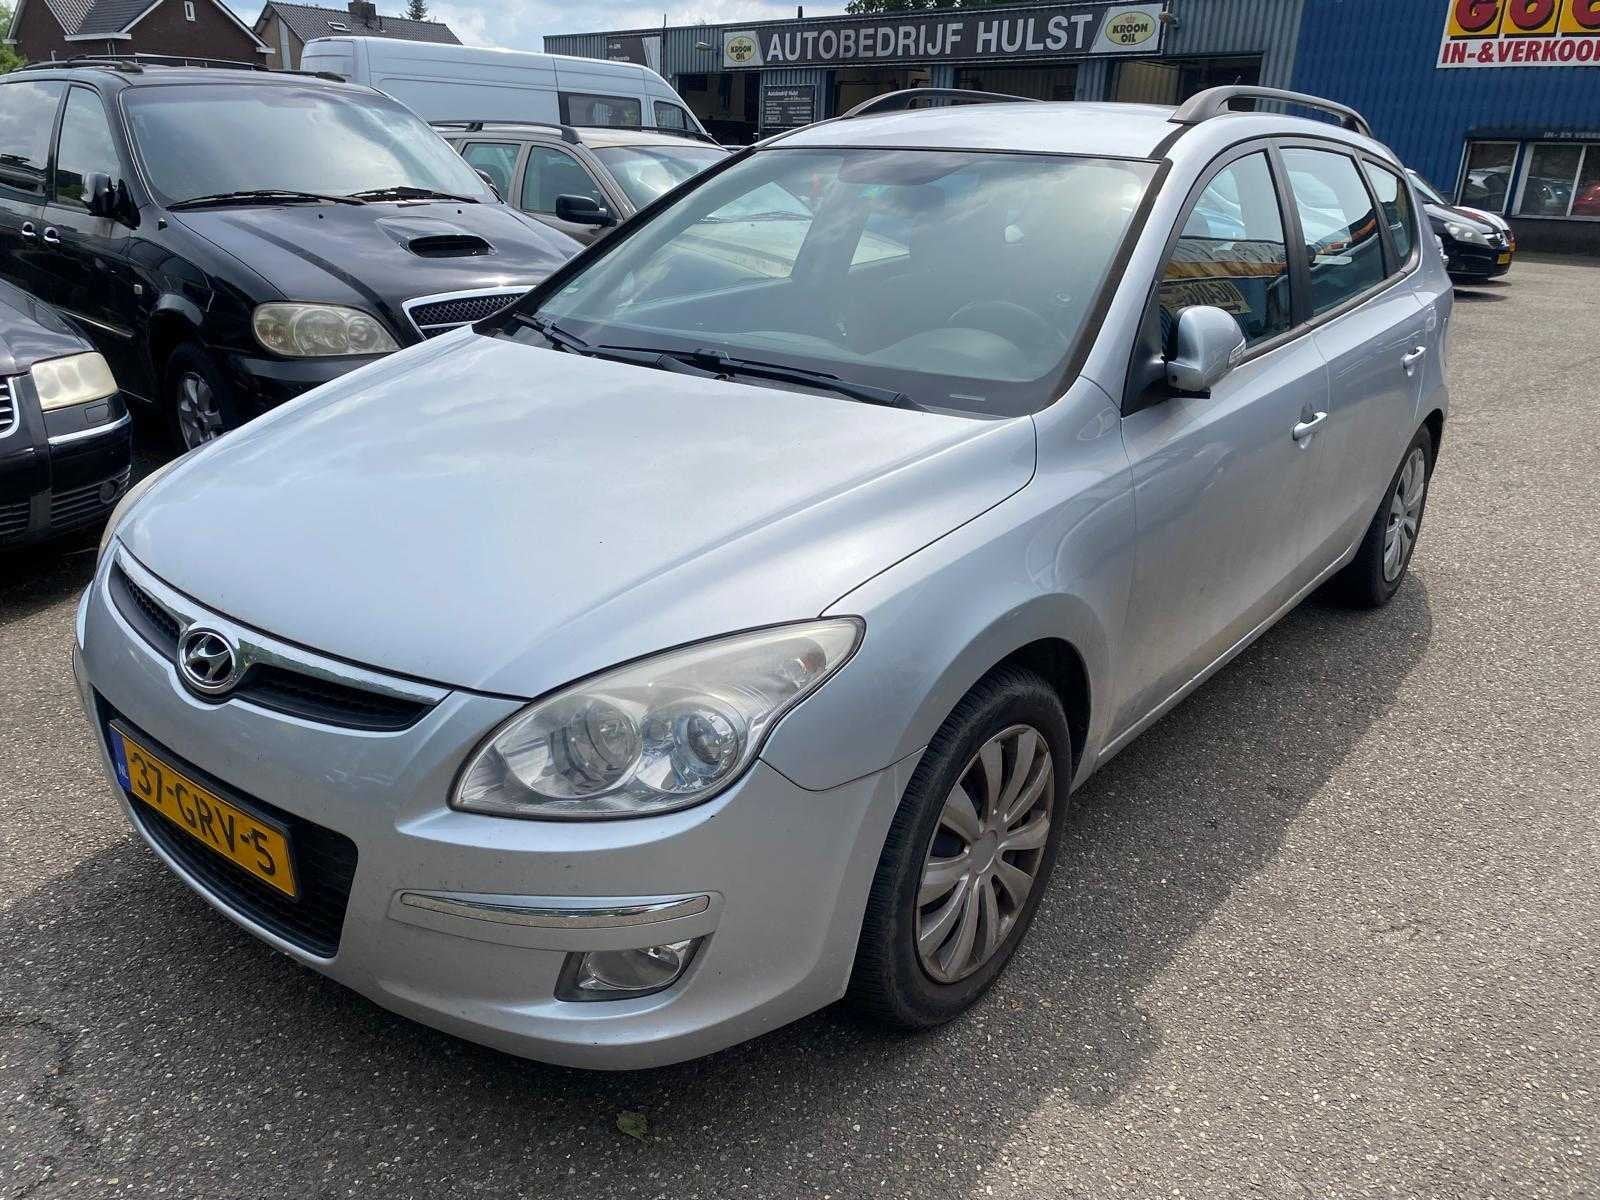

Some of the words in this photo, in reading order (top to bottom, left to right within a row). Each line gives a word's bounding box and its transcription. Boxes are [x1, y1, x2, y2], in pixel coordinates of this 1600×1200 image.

[1112, 23, 1148, 34] KROON
[766, 23, 964, 62] AUTOBEDRIJF
[976, 14, 1093, 53] HULST
[1121, 33, 1137, 43] OIL
[730, 45, 752, 53] KROON
[130, 752, 276, 876] 37-GRV-5
